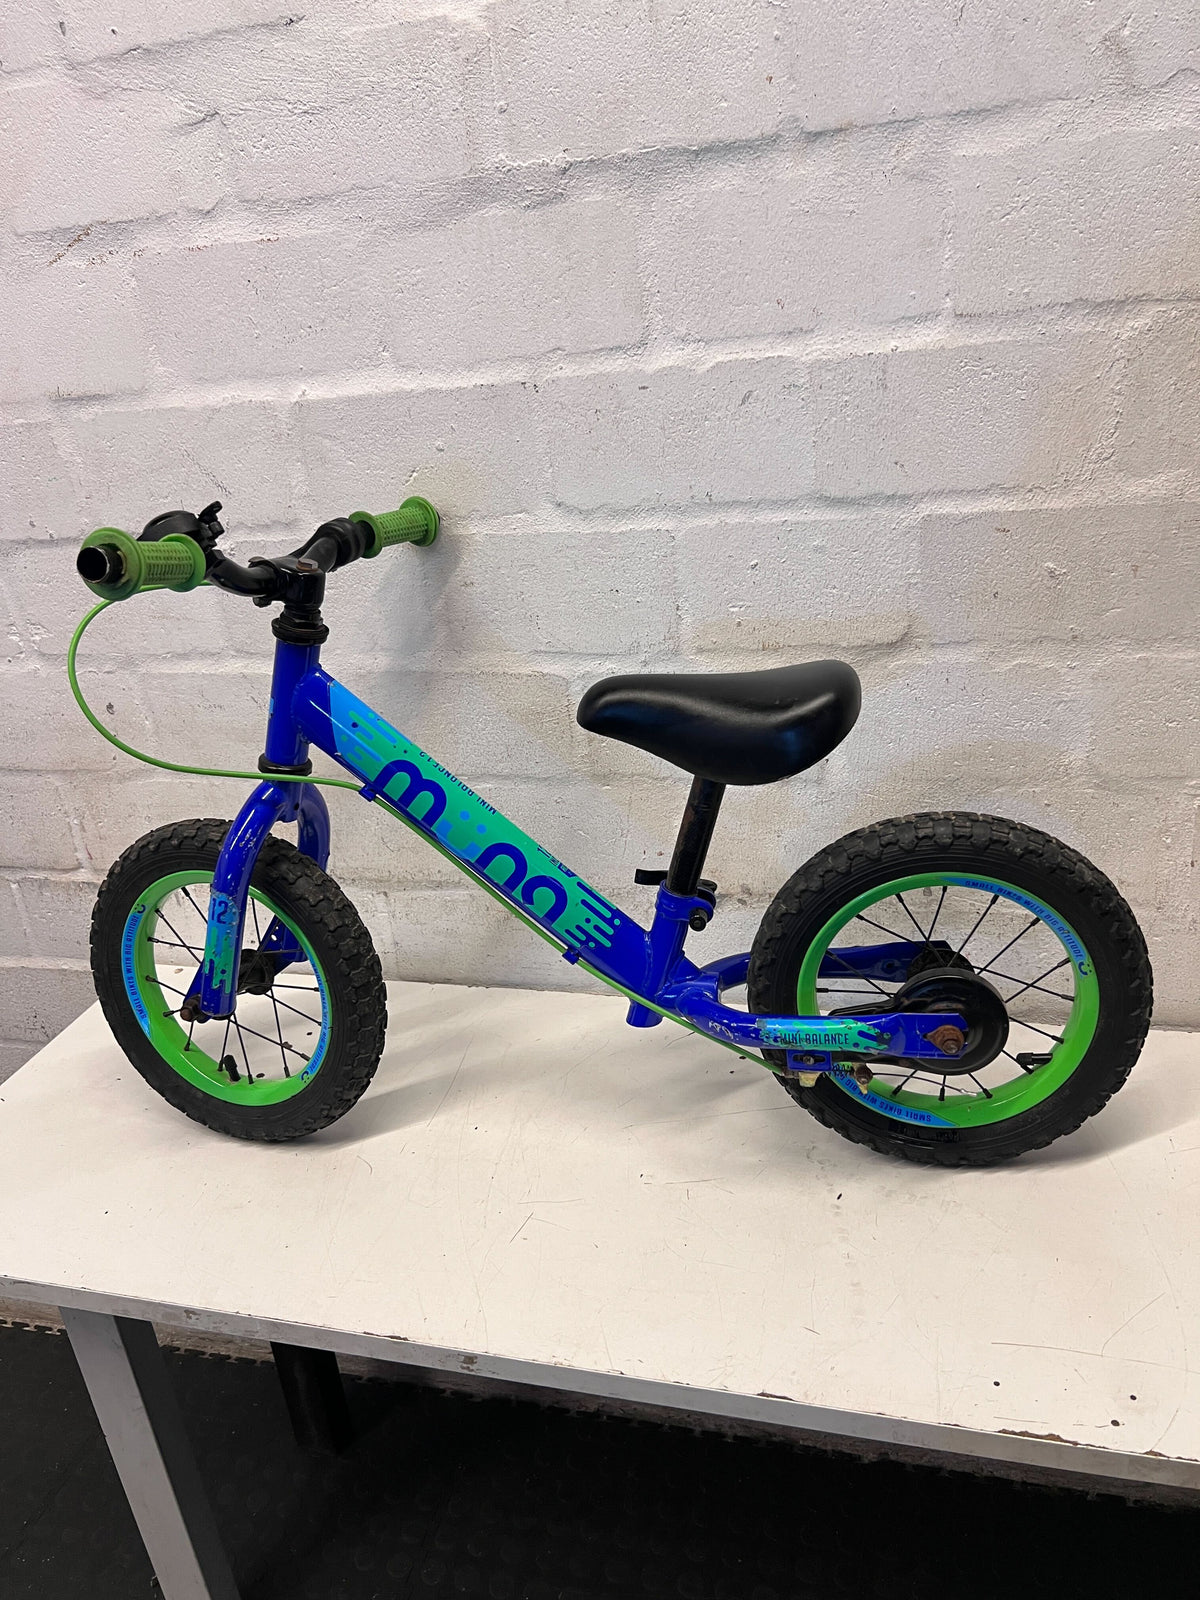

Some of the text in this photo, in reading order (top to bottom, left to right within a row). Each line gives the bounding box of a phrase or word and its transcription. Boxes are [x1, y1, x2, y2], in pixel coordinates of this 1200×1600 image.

[211, 897, 228, 924] 12
[1024, 899, 1044, 914] WITH
[1044, 913, 1058, 927] BIG
[780, 1031, 849, 1045] MINI BALANCE
[845, 1080, 858, 1092] BIG
[879, 1101, 903, 1116] BIKES
[905, 1110, 932, 1122] SMALL
